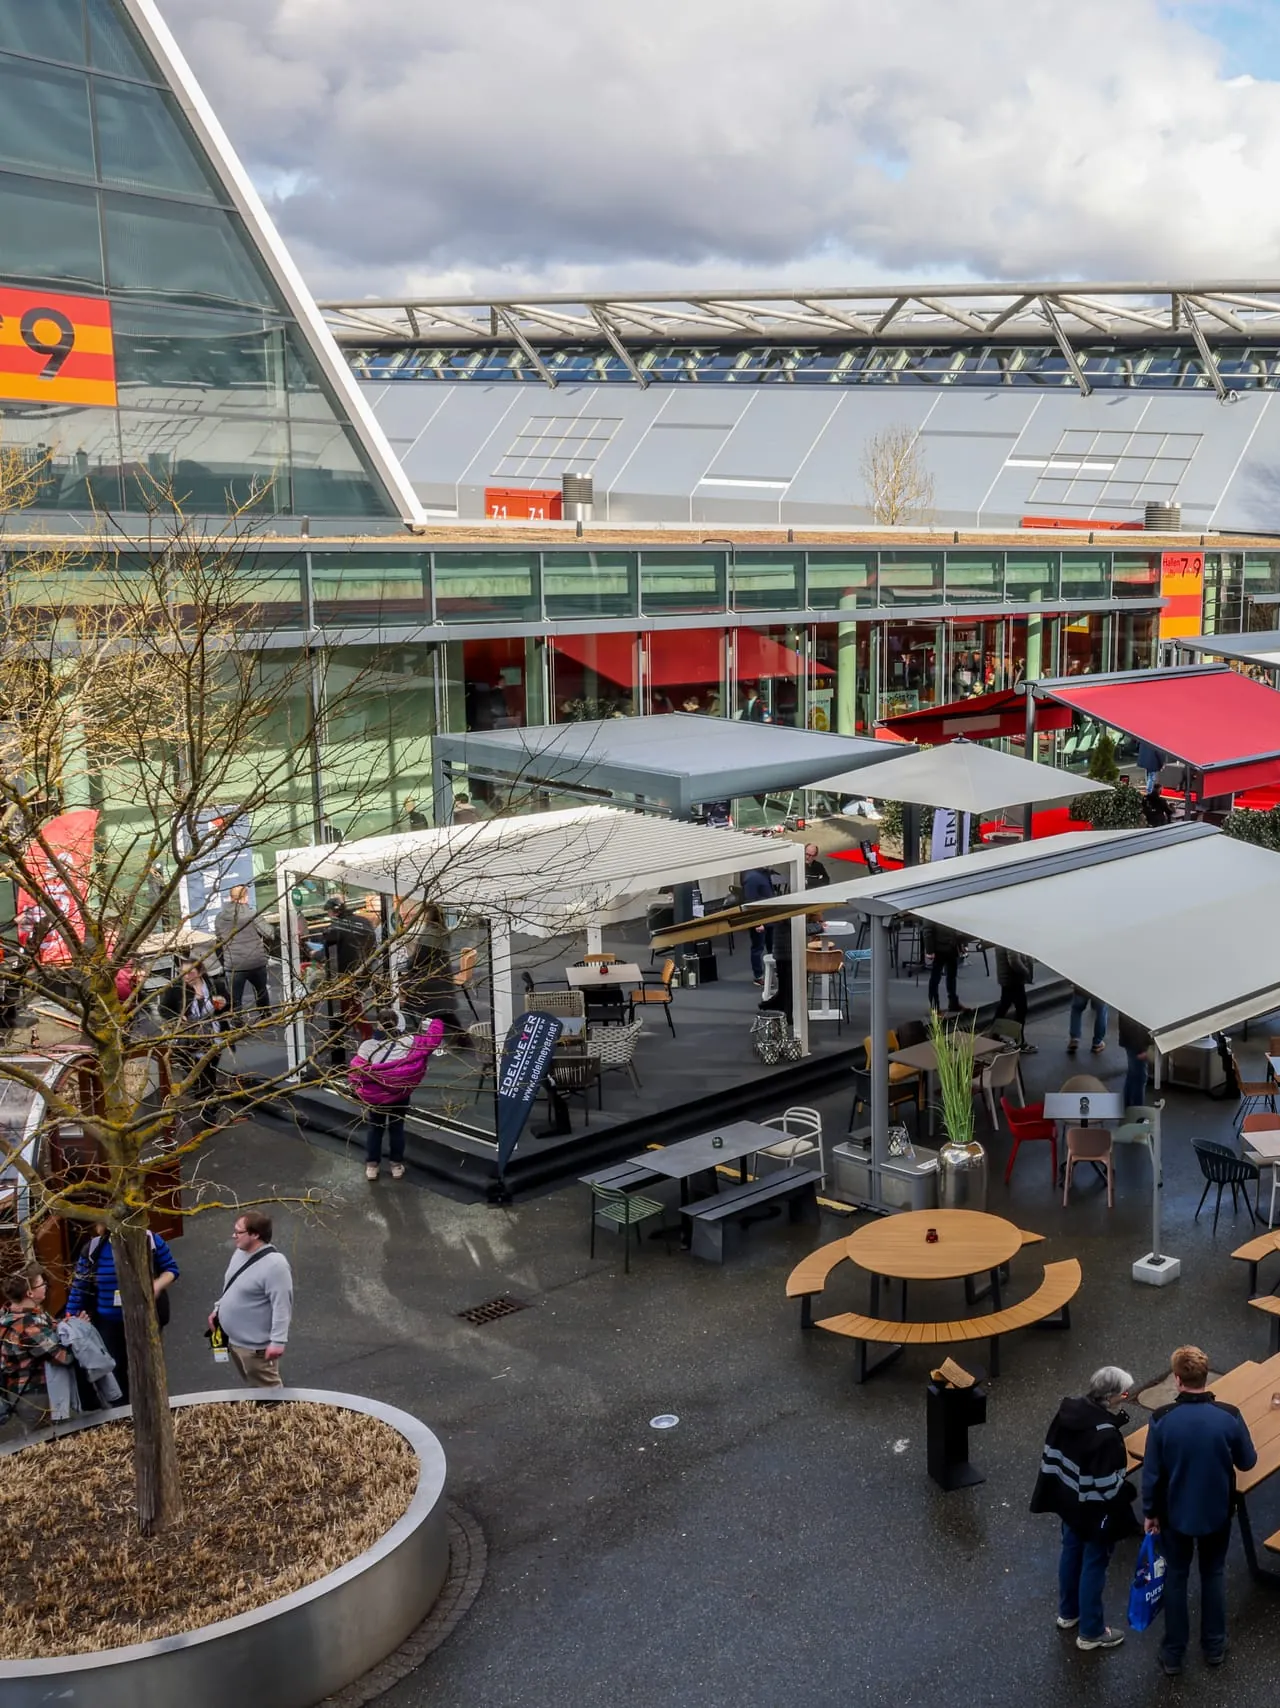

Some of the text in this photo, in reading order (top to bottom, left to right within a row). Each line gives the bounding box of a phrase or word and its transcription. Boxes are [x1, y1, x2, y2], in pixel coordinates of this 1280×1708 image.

[20, 307, 75, 380] 9
[500, 1015, 537, 1096] EDELMEYER
[522, 1022, 559, 1101] www.edelmeyer.net
